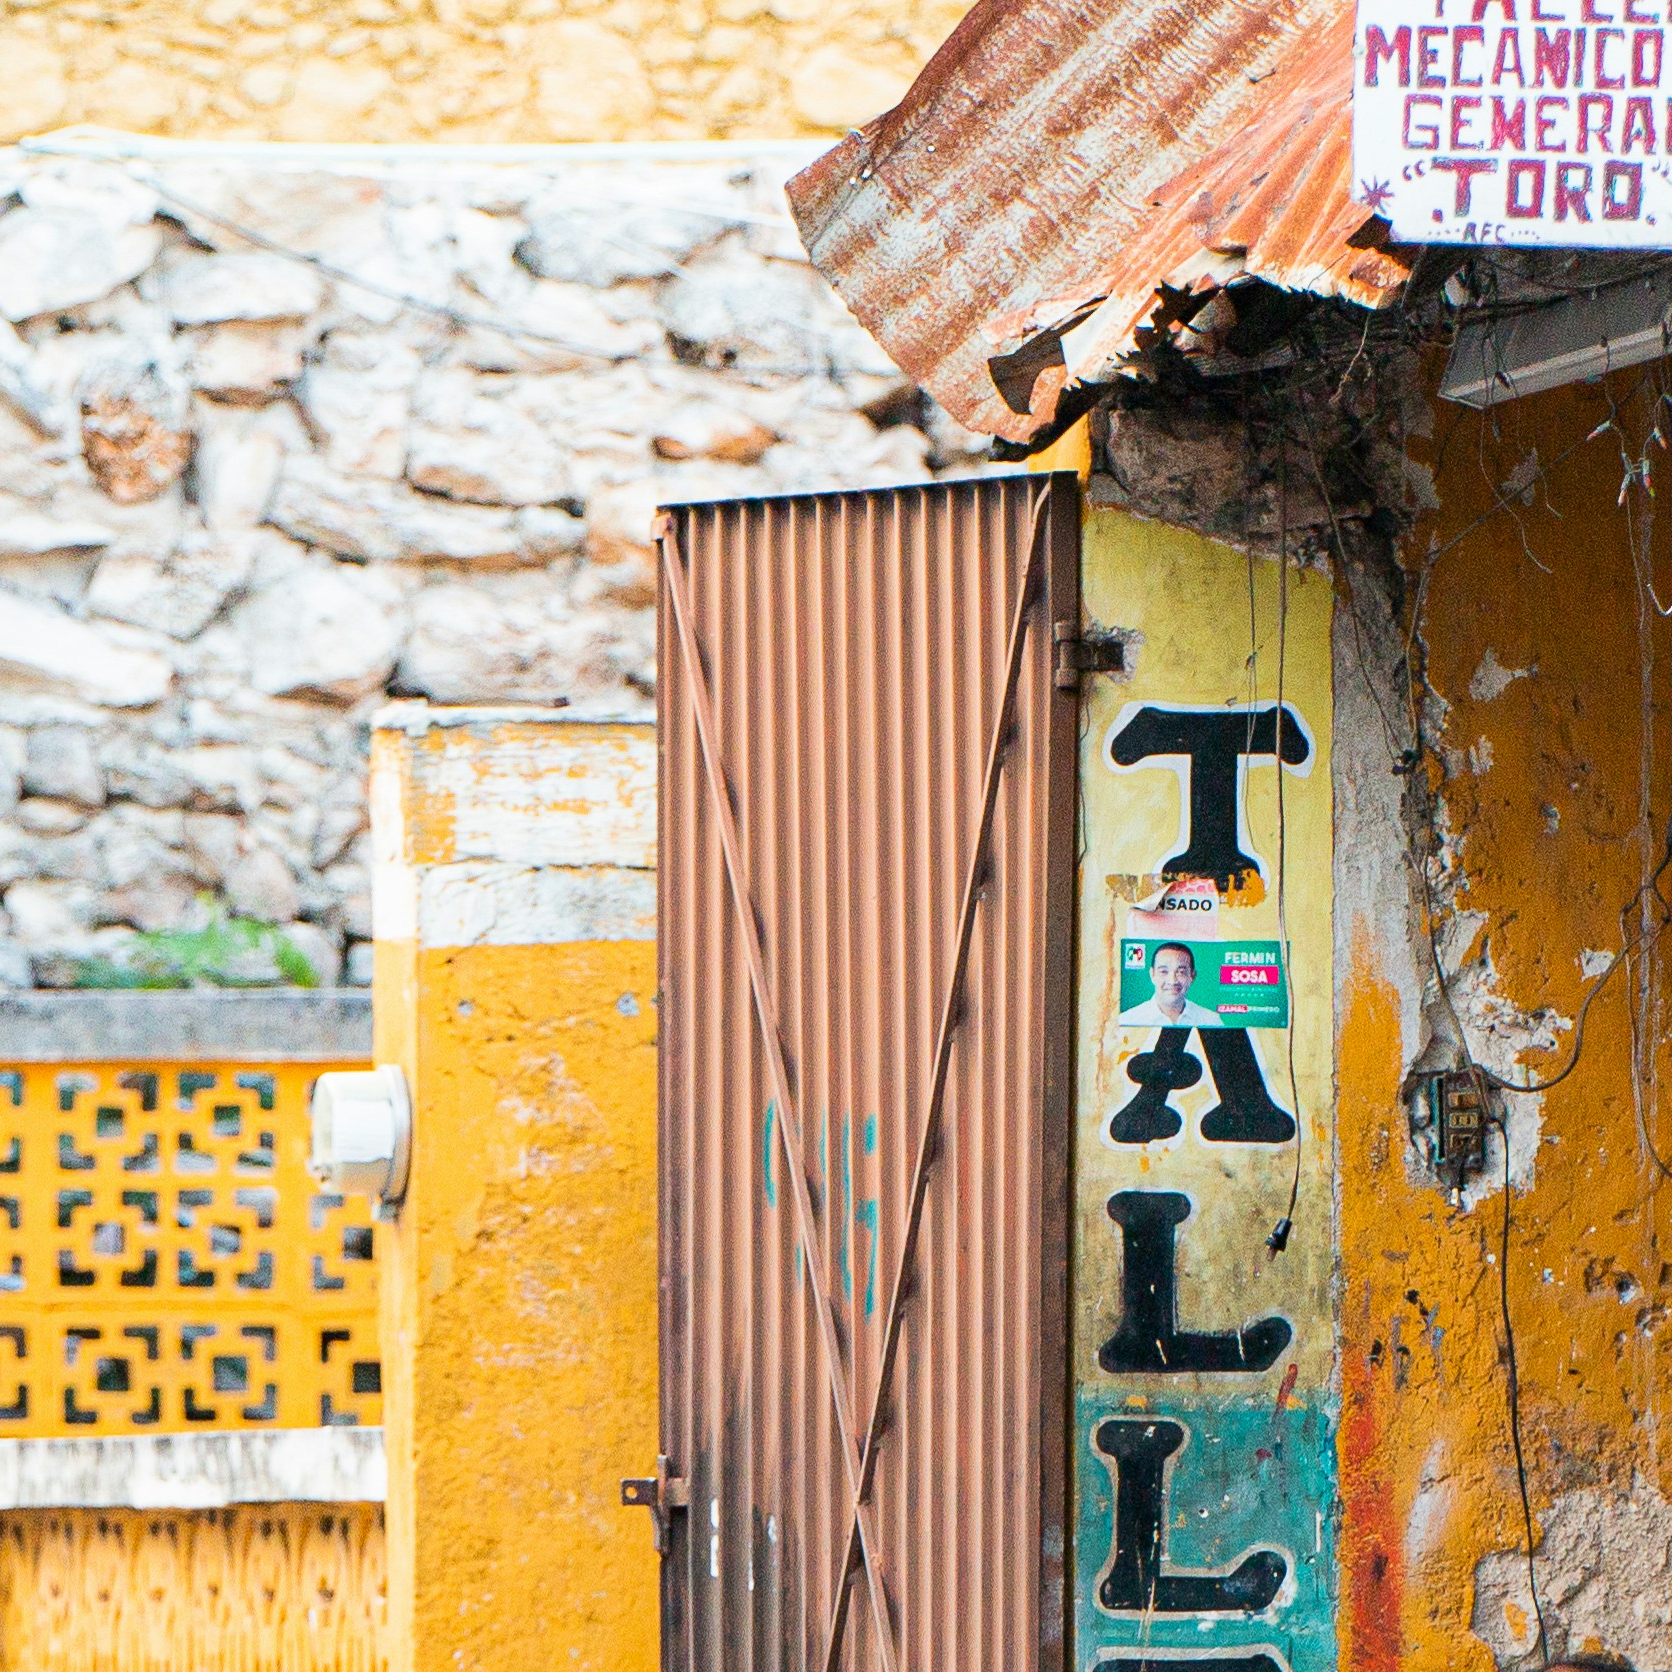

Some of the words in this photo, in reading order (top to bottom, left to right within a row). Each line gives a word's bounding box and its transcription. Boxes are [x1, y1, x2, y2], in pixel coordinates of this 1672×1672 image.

[1364, 24, 1664, 89] MECANICO
[1224, 951, 1276, 964] FERMIN
[1230, 969, 1269, 983] SOSA
